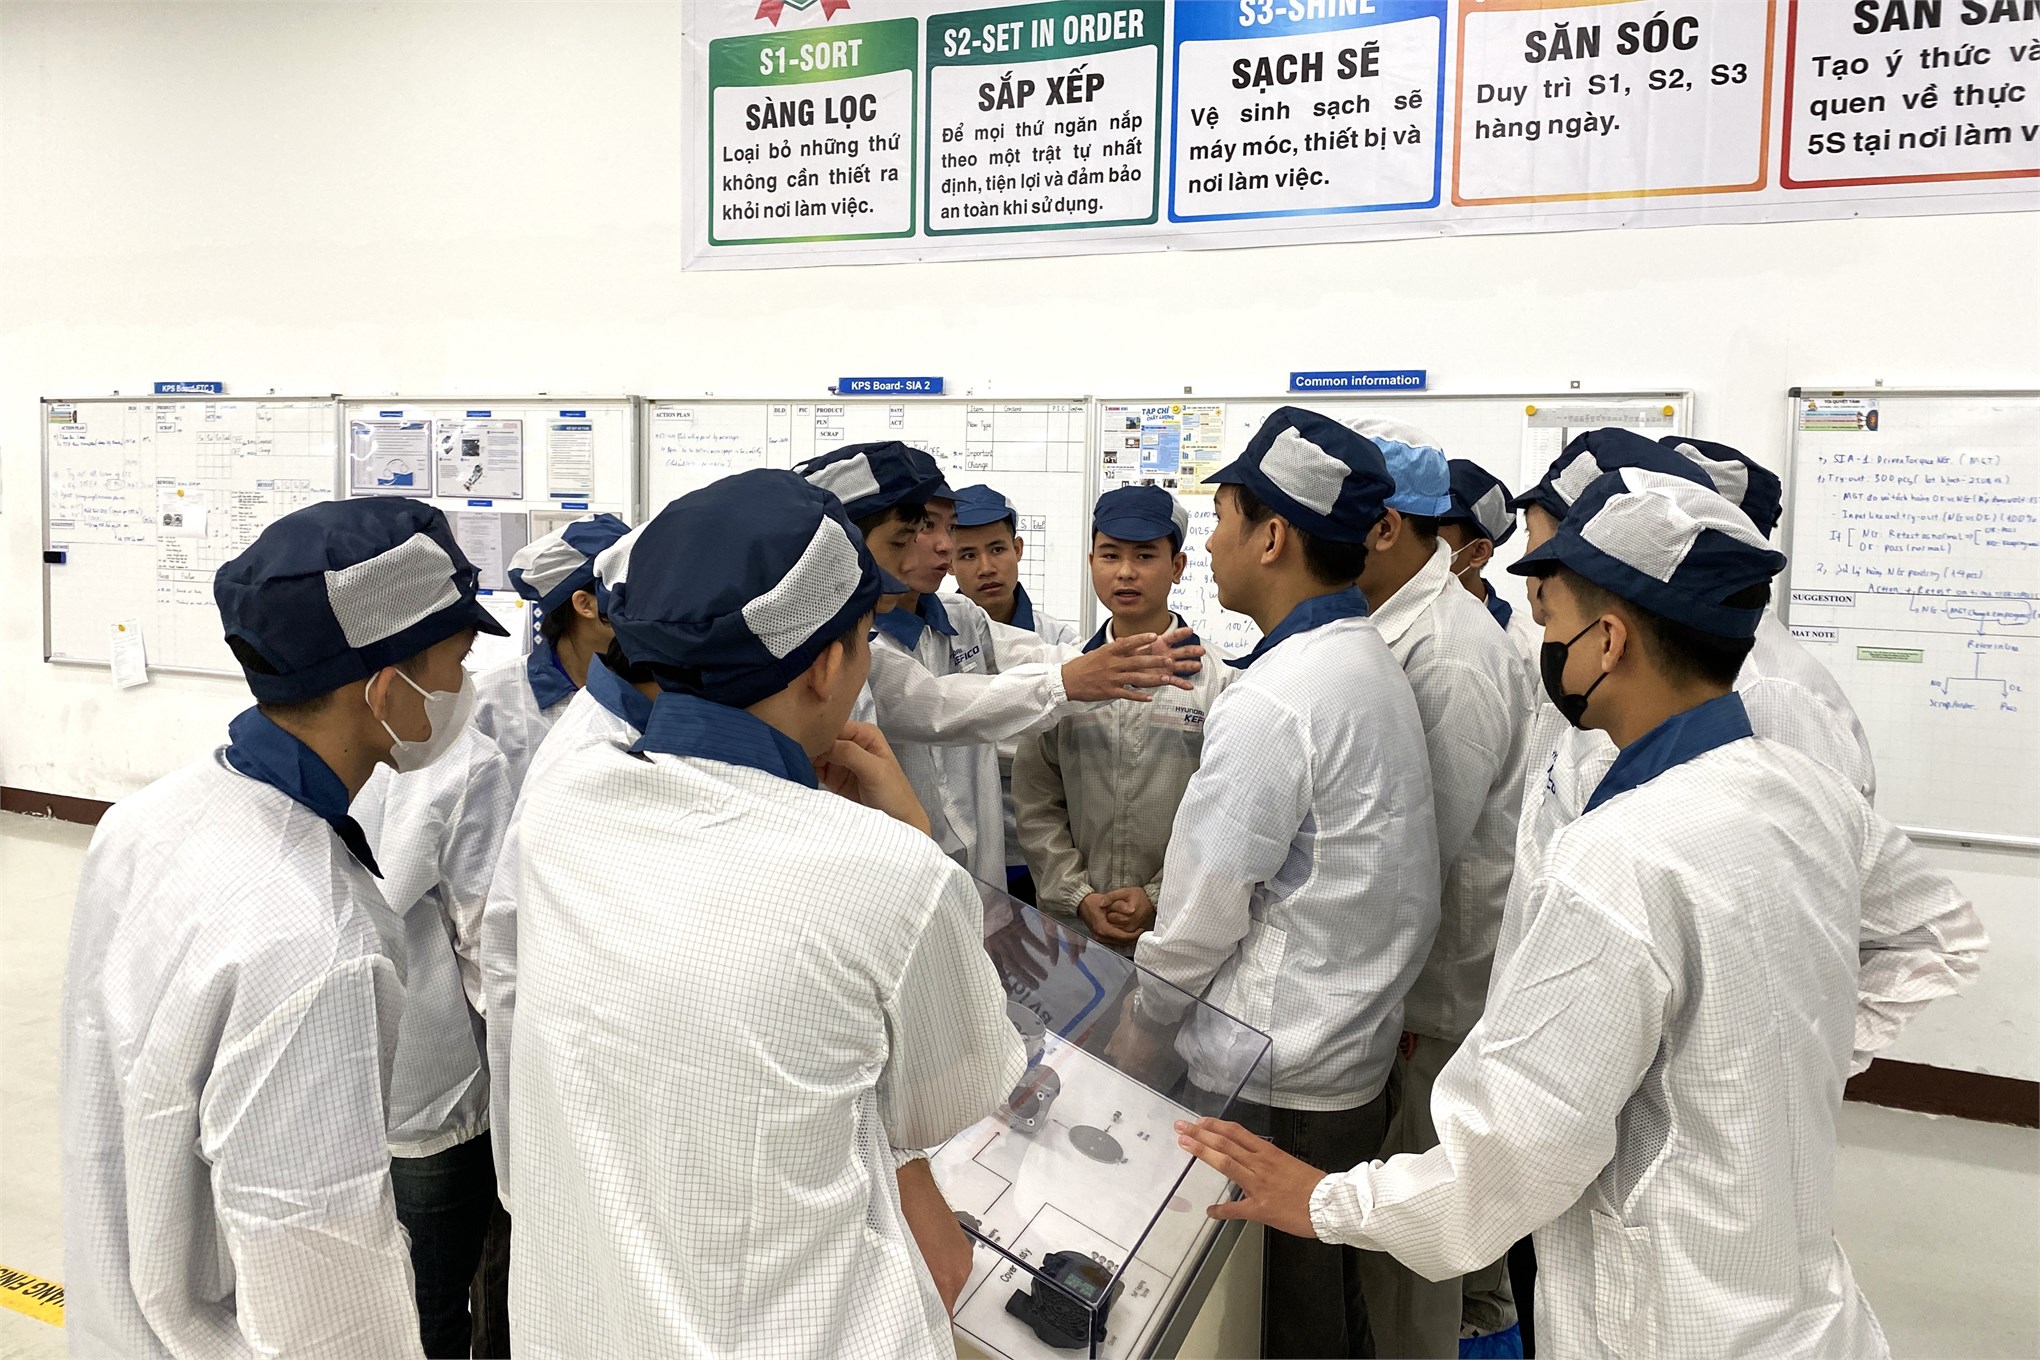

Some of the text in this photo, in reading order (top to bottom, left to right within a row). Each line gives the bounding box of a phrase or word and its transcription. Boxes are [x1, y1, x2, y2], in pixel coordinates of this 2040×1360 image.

[944, 8, 1144, 57] S2-SET IN ORDER
[1524, 11, 1700, 64] SĂN SÓC
[760, 39, 862, 76] S1-SORT
[1231, 40, 1381, 93] SẠCH SẼ
[1811, 39, 2040, 81] Tạo ý thức và
[978, 63, 1105, 111] SẮP XẾP
[1477, 63, 1748, 106] Duy trì S1, S2, S3
[745, 93, 877, 131] SÀNG LỌC
[1191, 88, 1423, 129] Vệ sinh sạch sẽ
[1809, 83, 2026, 121] quen về thực
[942, 110, 1142, 143] Để mọi thứ ngăn nắp
[1475, 111, 1620, 144] hàng ngày.
[1807, 123, 2011, 156] 5S tại nơi làm
[723, 132, 901, 163] Loại bỏ những thứ
[941, 136, 1142, 168] theo một trật tự nhất
[1189, 125, 1422, 164] máy móc, thiết bị và
[723, 164, 899, 192] không cần thiết ra
[941, 164, 1142, 197] định, tiện lợi và đảm bảo
[1188, 164, 1331, 194] nơi làm việc.
[723, 196, 874, 221] khỏi nơi làm việc.
[941, 195, 1104, 219] an toàn khi sử dụng.
[162, 384, 175, 392] KPS
[851, 380, 931, 390] KPS Board- SIA 2
[1295, 375, 1420, 387] Common information
[966, 448, 993, 460] Important
[967, 461, 989, 471] Change
[1874, 474, 1894, 483] 300
[1792, 593, 1853, 603] SUGGESTION
[1792, 629, 1836, 639] MAT NOTE
[1000, 1264, 1018, 1283] Cover
